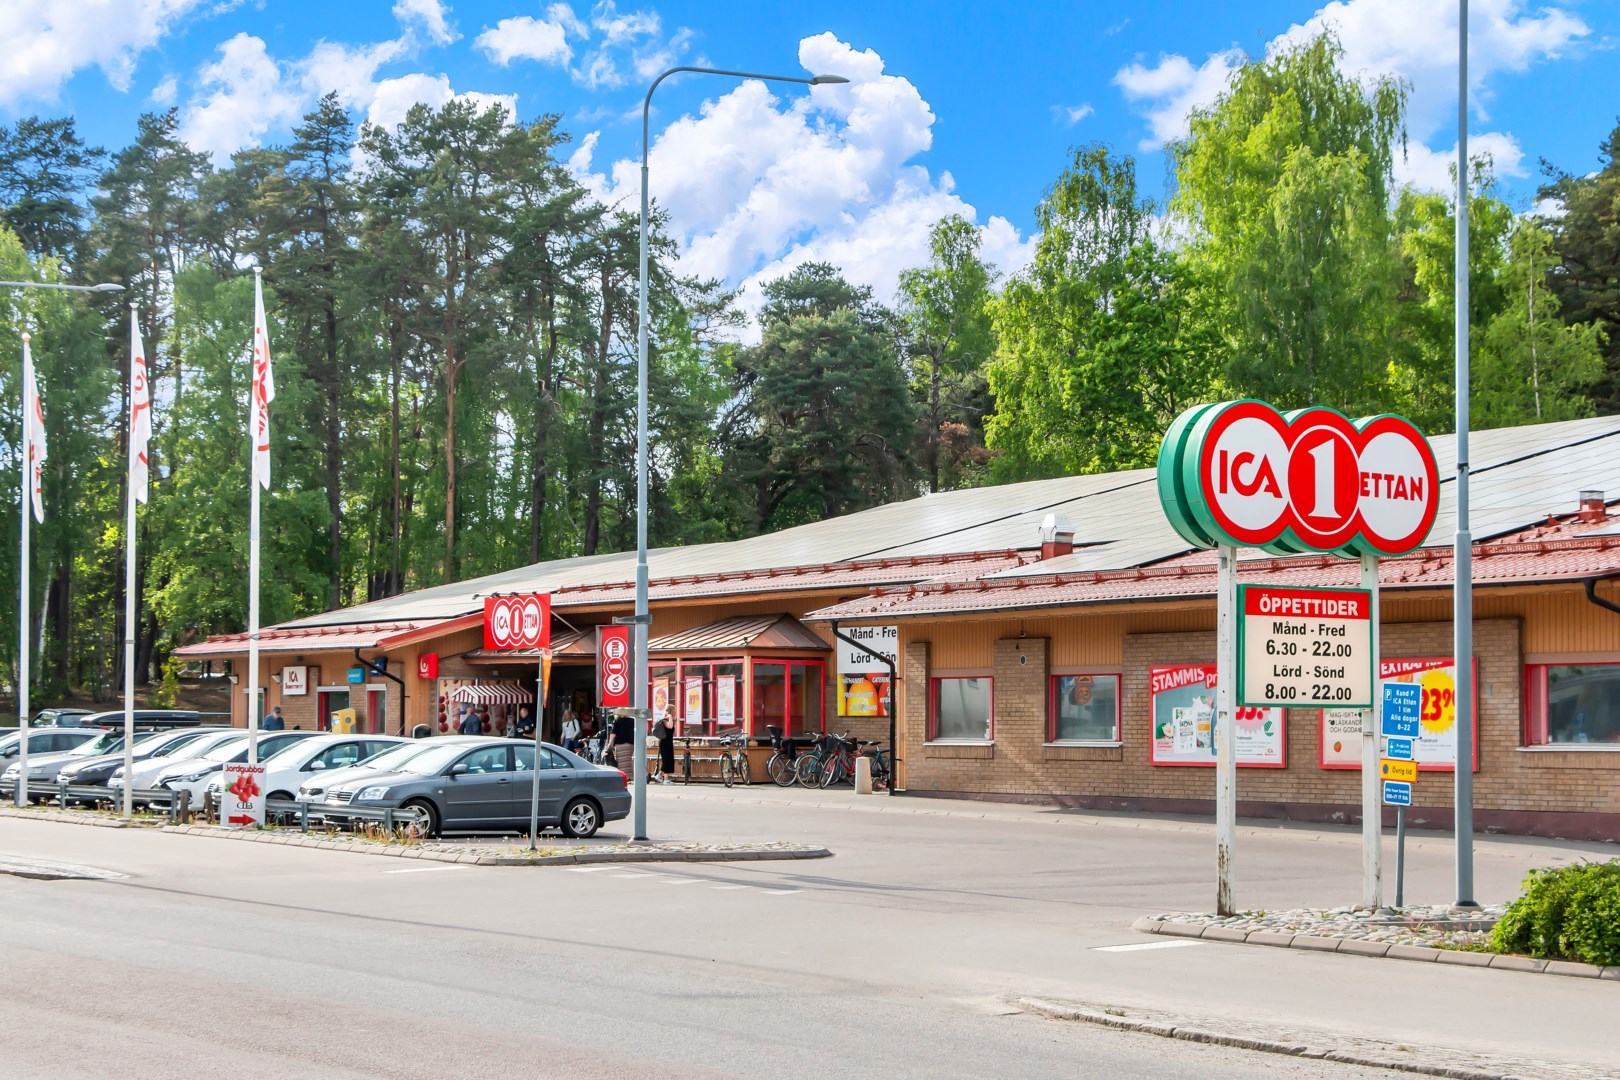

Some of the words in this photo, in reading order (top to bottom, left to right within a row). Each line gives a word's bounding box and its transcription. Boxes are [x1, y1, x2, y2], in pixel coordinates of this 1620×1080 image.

[1219, 450, 1283, 498] ICA
[1308, 438, 1342, 519] 1
[1360, 472, 1423, 501] ETTAN
[1260, 594, 1358, 616] ÖPPETTIDER
[496, 615, 508, 630] ICA
[524, 613, 538, 630] ETTAN
[1273, 621, 1306, 635] Månd
[1318, 624, 1346, 637] Fred
[849, 627, 873, 639] Månd
[611, 641, 619, 657] ETTAN
[1266, 639, 1297, 655] 6.30
[1312, 641, 1352, 657] 22.00
[851, 653, 871, 663] Lörd
[289, 671, 299, 682] ICA
[1152, 667, 1205, 692] STAMMIS
[1273, 665, 1302, 677] Lörd
[1314, 666, 1344, 678] Sönd
[612, 676, 620, 690] ICA
[1265, 683, 1296, 699] 8.00
[1311, 684, 1352, 700] 22.00
[1391, 766, 1405, 775] Övrig
